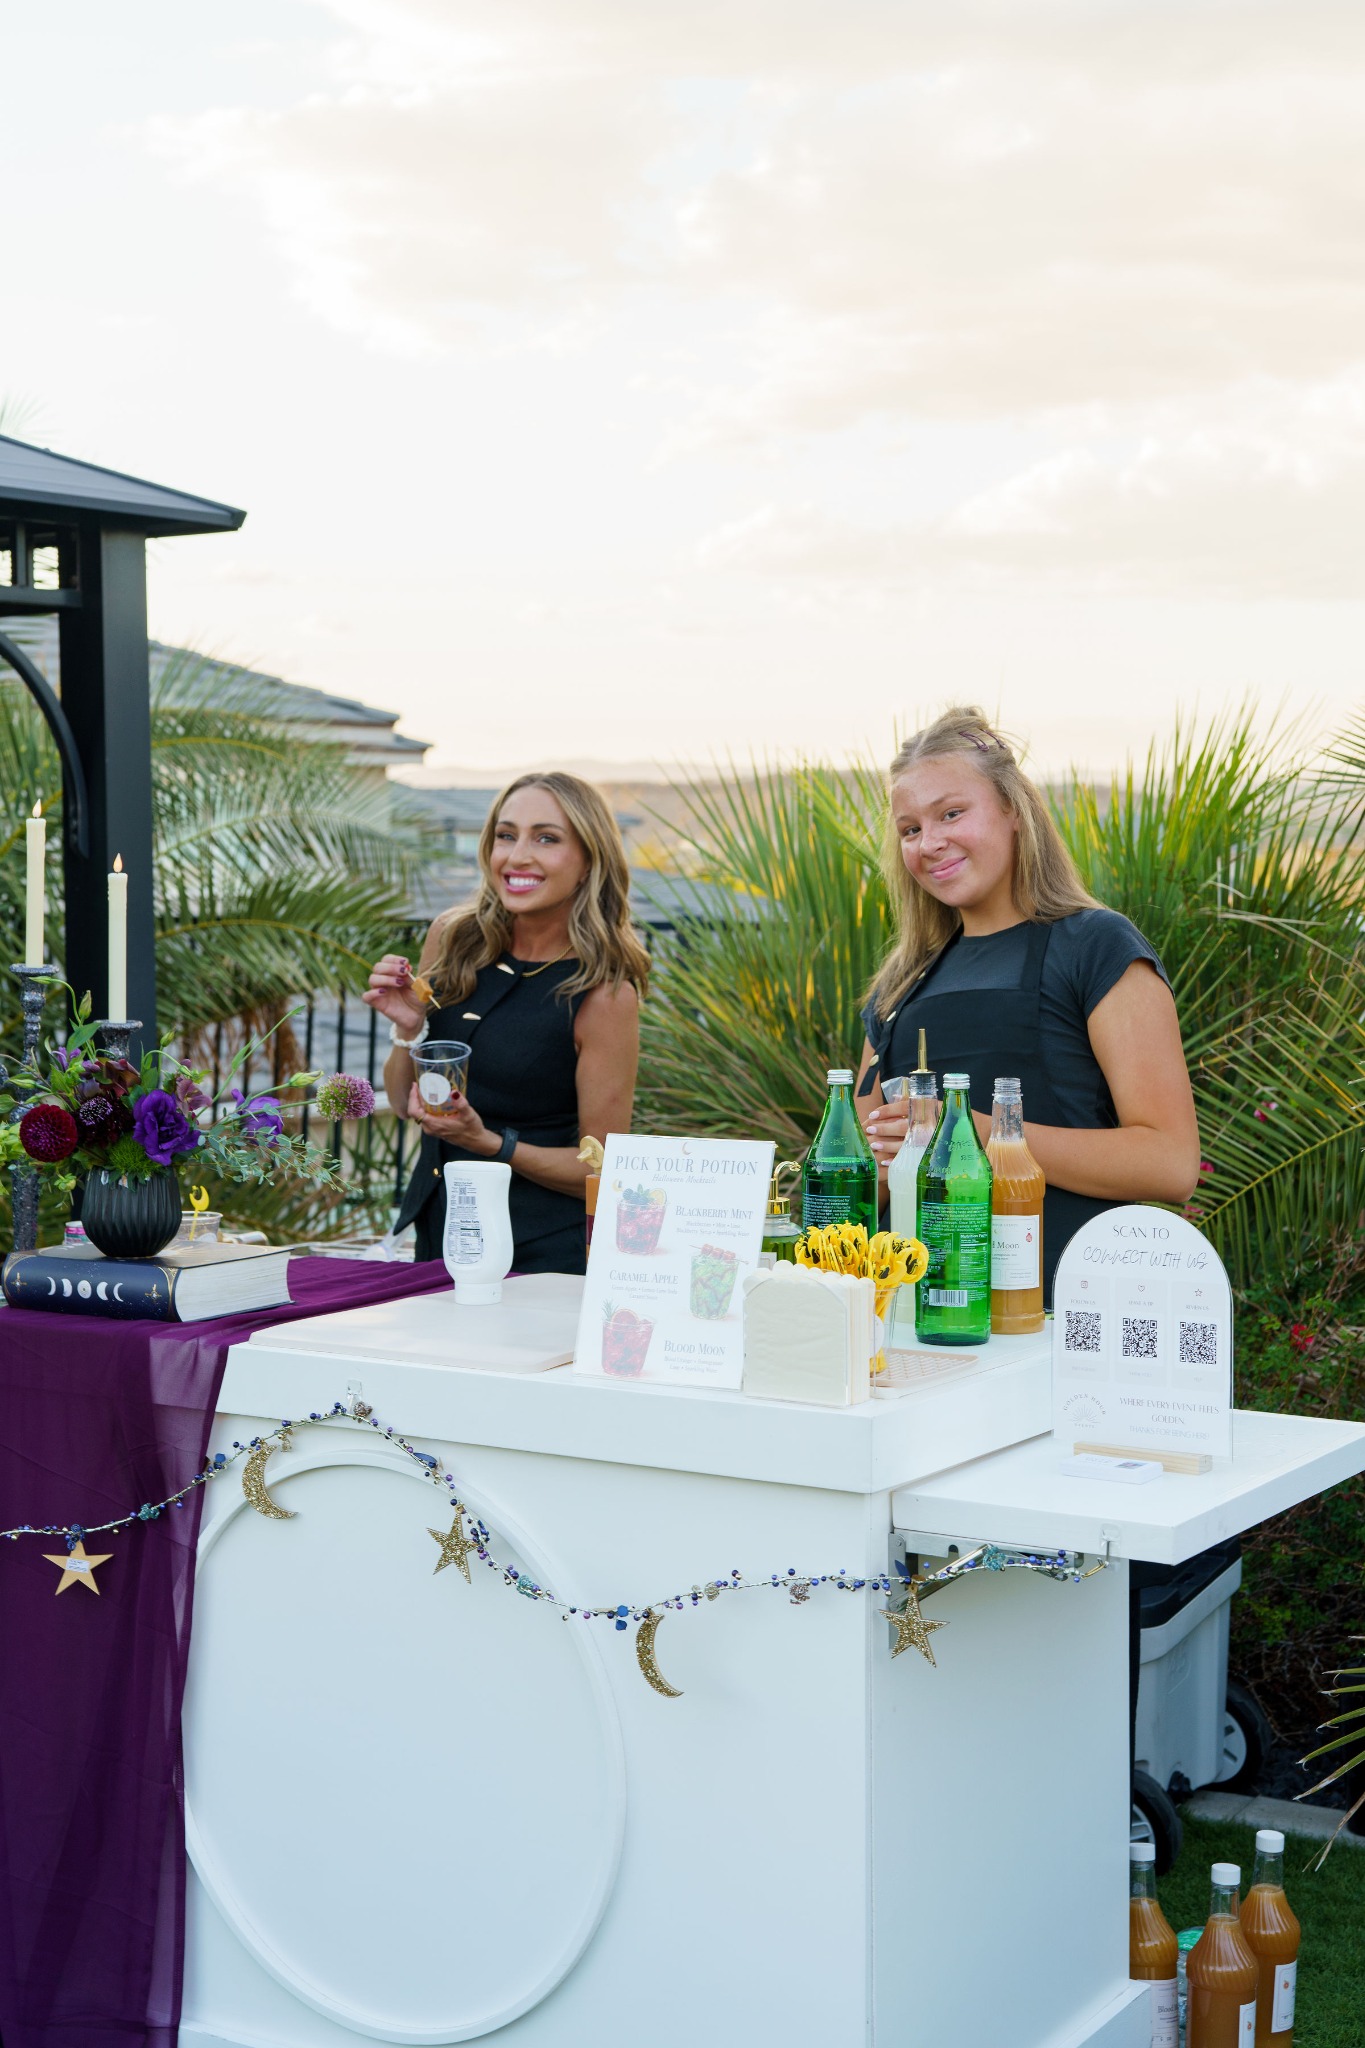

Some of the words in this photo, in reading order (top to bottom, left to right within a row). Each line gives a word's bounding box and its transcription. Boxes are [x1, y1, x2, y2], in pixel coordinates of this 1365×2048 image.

[615, 1155, 650, 1171] PICK
[656, 1157, 694, 1173] YOUR
[701, 1159, 759, 1176] POTION
[651, 1174, 683, 1183] Halloween
[685, 1175, 717, 1184] Mocktails
[1112, 1224, 1147, 1238] SCAN
[1152, 1227, 1170, 1240] TO
[997, 1240, 1020, 1250] Moon
[1083, 1246, 1149, 1265] CONNECT
[1150, 1250, 1181, 1269] WITH
[1187, 1252, 1209, 1270] US
[1063, 1393, 1088, 1411] GOLDEN
[1091, 1396, 1106, 1415] HOUR
[1119, 1397, 1144, 1407] WHERE
[1146, 1399, 1170, 1410] EVERY
[1172, 1401, 1196, 1412] EVENT
[1199, 1404, 1220, 1415] FEELS
